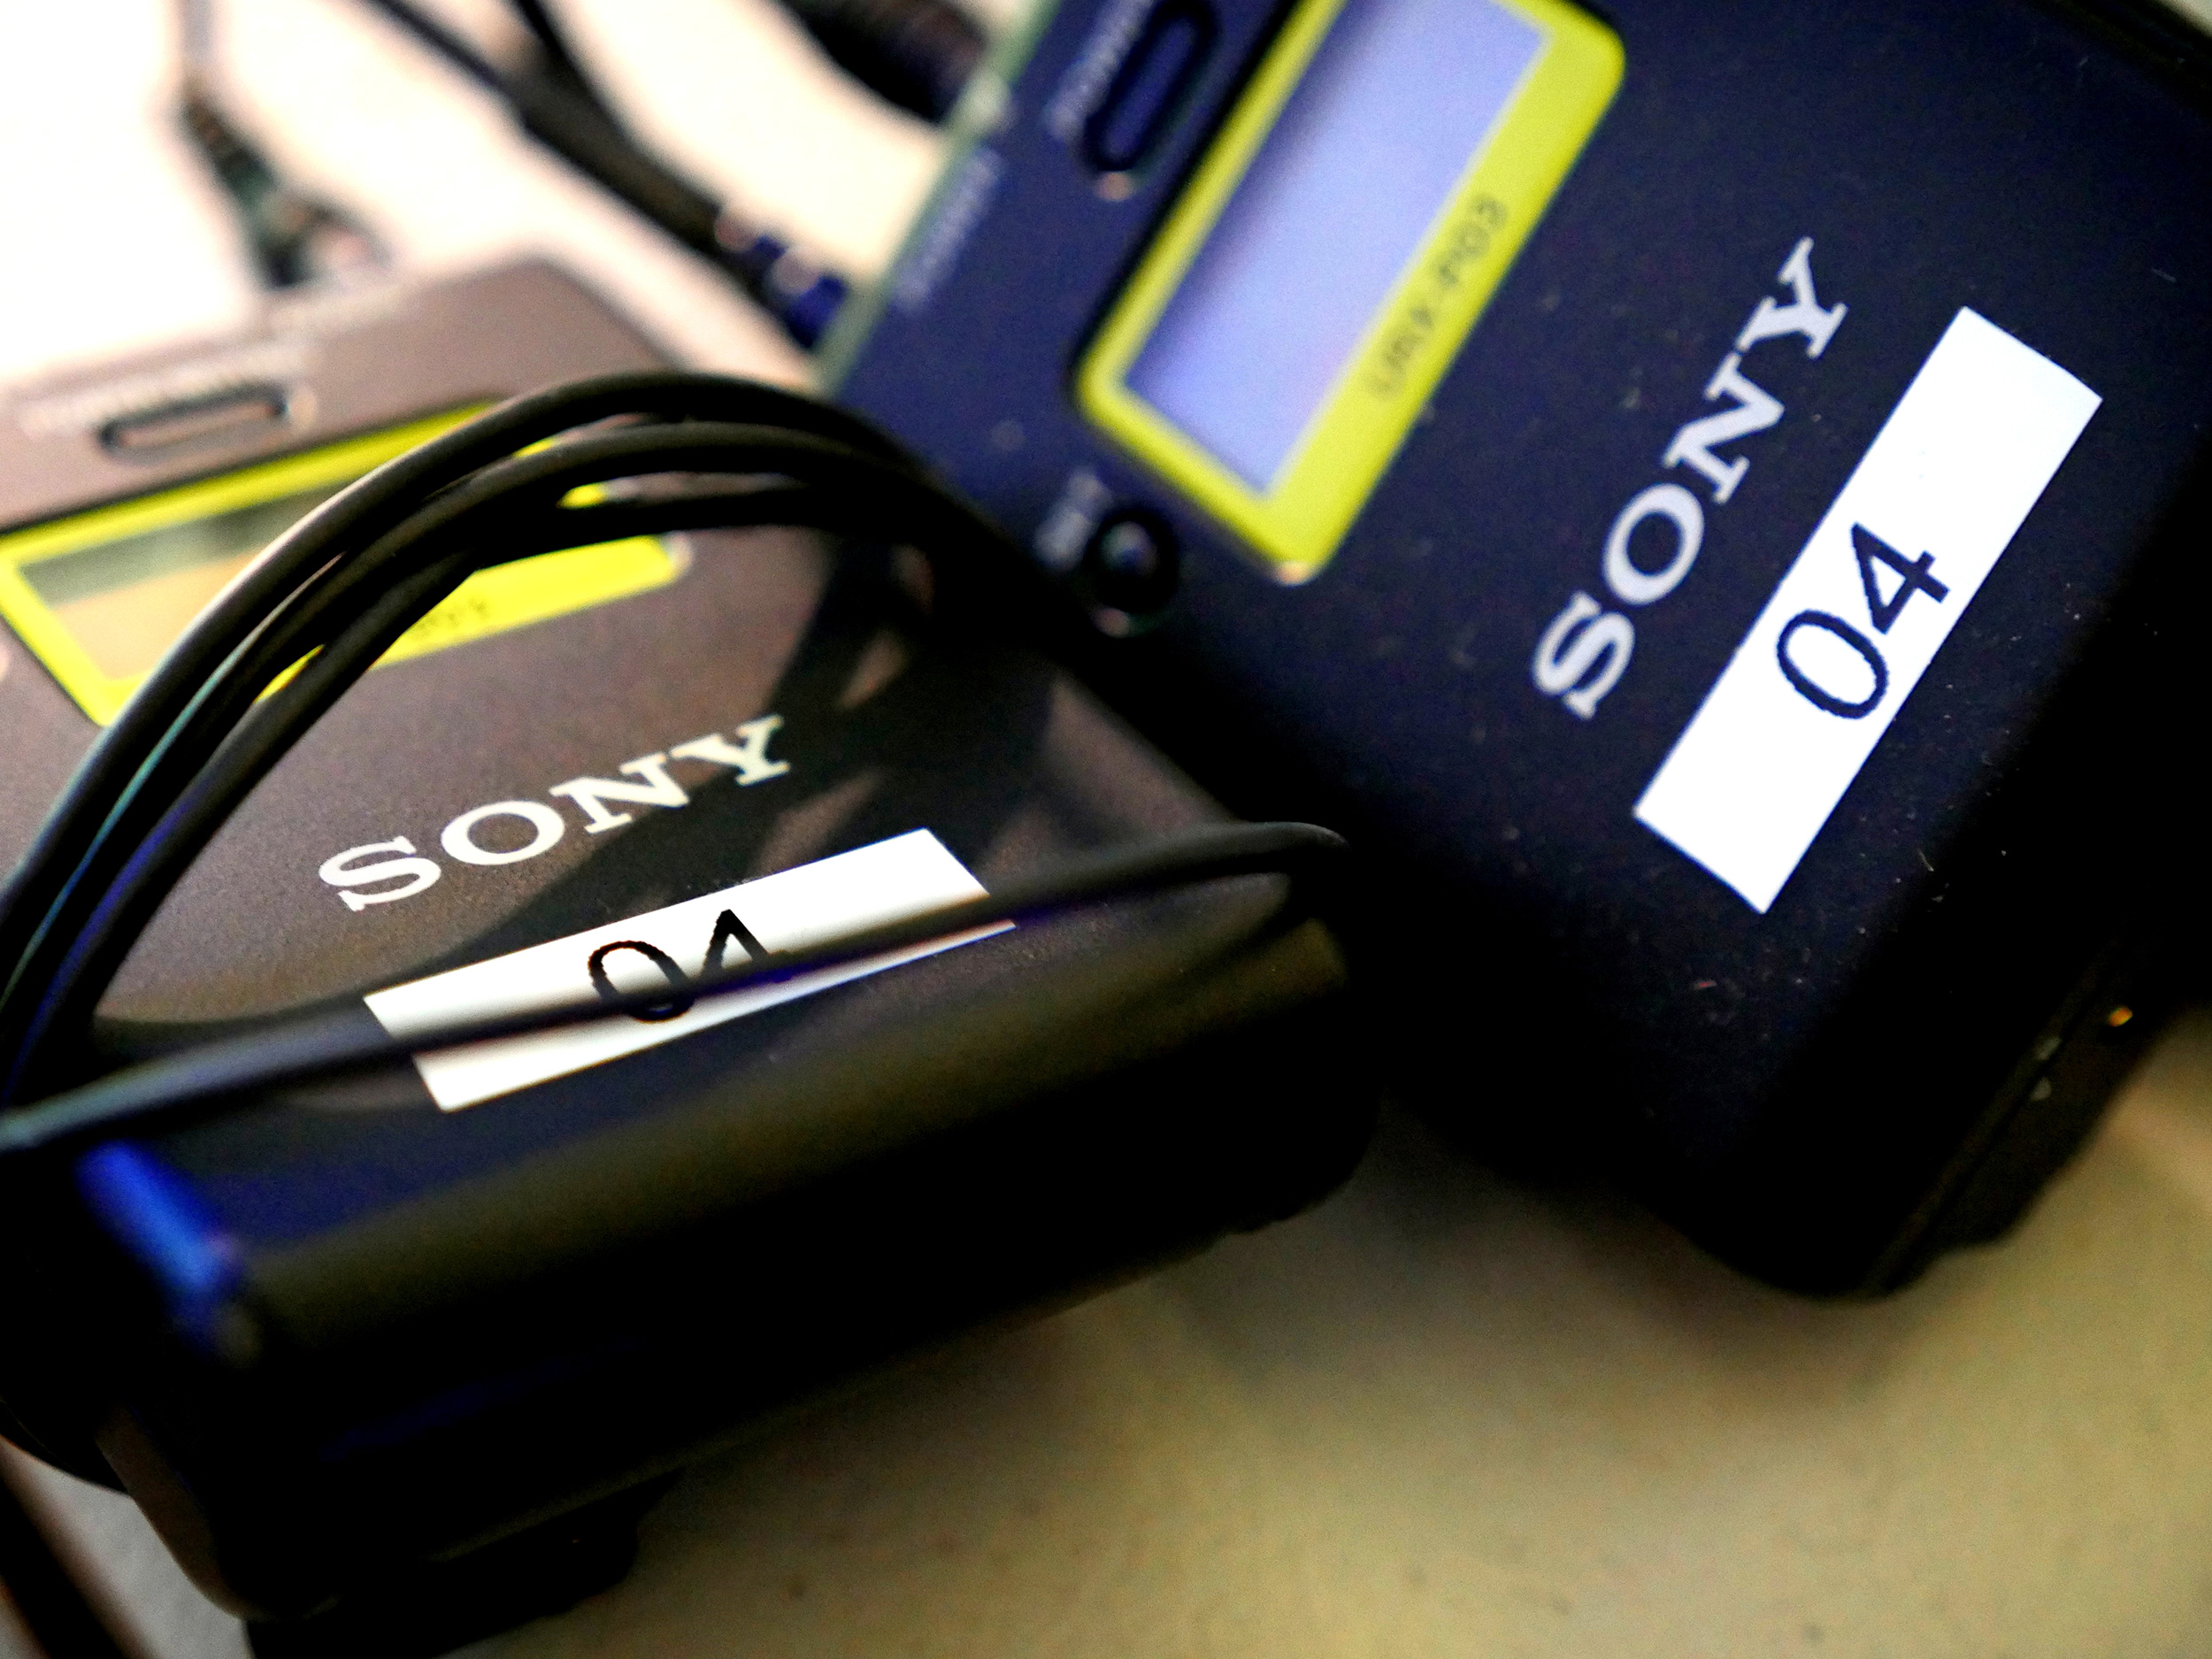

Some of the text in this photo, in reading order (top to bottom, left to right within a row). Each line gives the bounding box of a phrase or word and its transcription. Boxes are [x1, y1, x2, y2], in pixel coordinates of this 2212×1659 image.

[1533, 237, 1847, 718] SONY
[1777, 522, 1949, 719] 04
[319, 715, 787, 913] SONY
